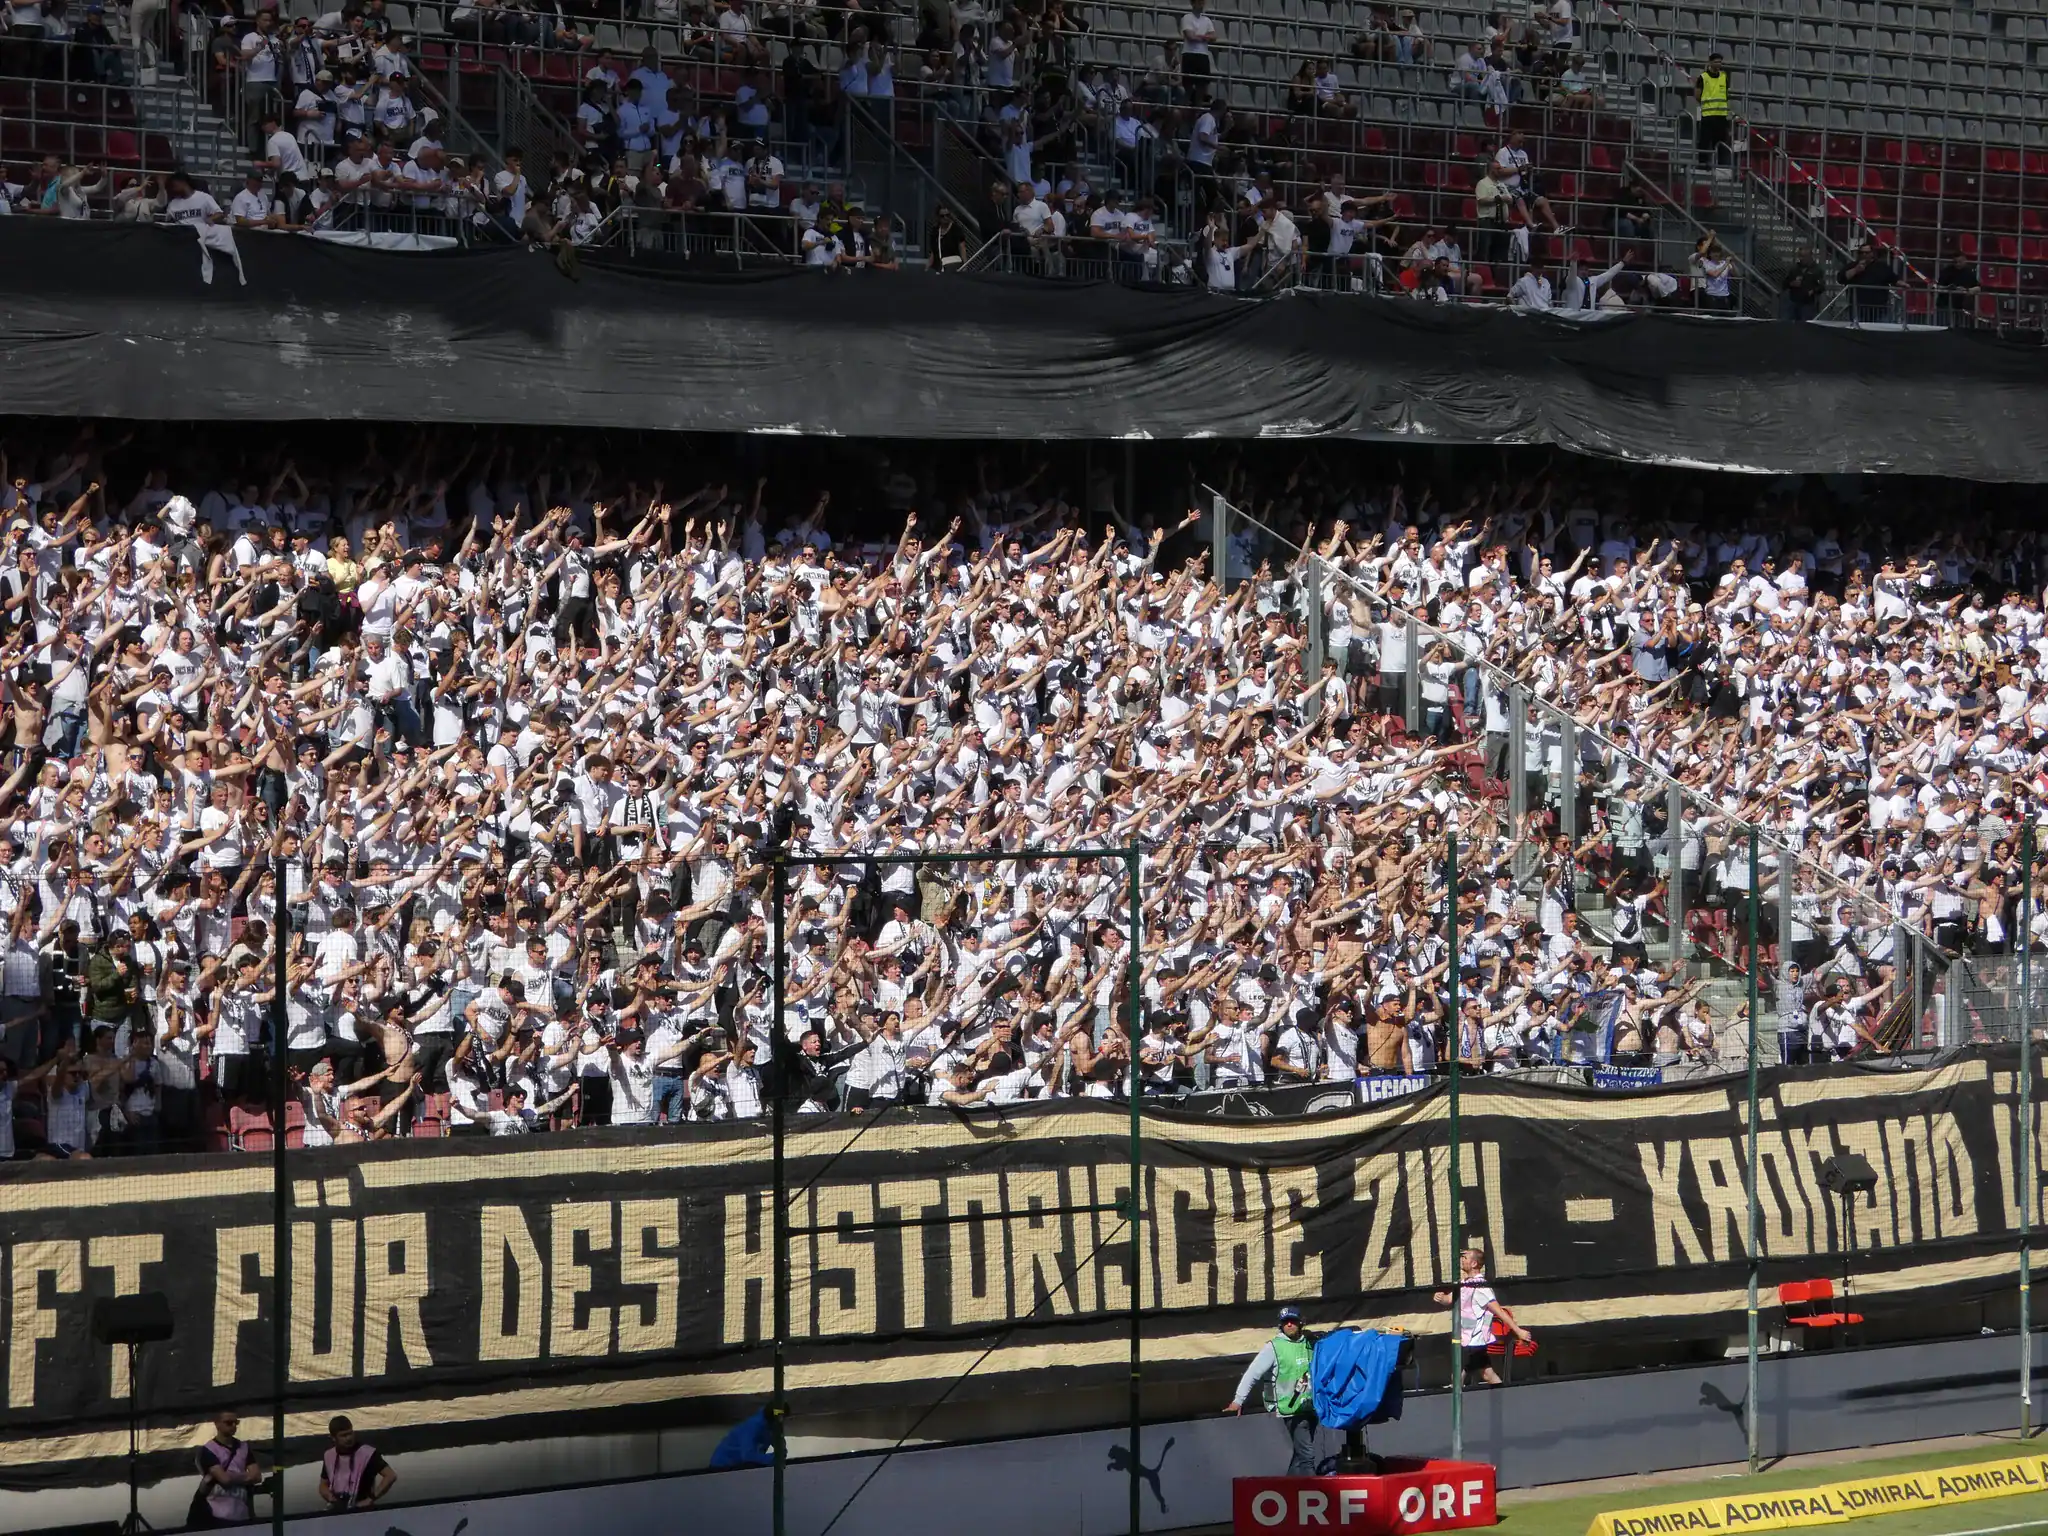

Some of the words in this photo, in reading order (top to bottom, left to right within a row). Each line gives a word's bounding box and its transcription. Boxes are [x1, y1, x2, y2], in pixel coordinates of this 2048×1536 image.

[0, 1233, 164, 1408] FT
[212, 1177, 434, 1387] FÜR
[479, 1198, 679, 1361] DES
[723, 1163, 1324, 1343] HISTORISCHE
[1353, 1141, 1528, 1292] ZIEL
[1992, 1071, 2048, 1229] Ü
[1398, 1480, 1484, 1522] ORF
[1938, 1464, 2039, 1498] ADMIRAL
[1251, 1489, 1368, 1526] ORF
[1612, 1507, 1721, 1536] ADMIRAL
[1726, 1494, 1844, 1525] ADMIRAL
